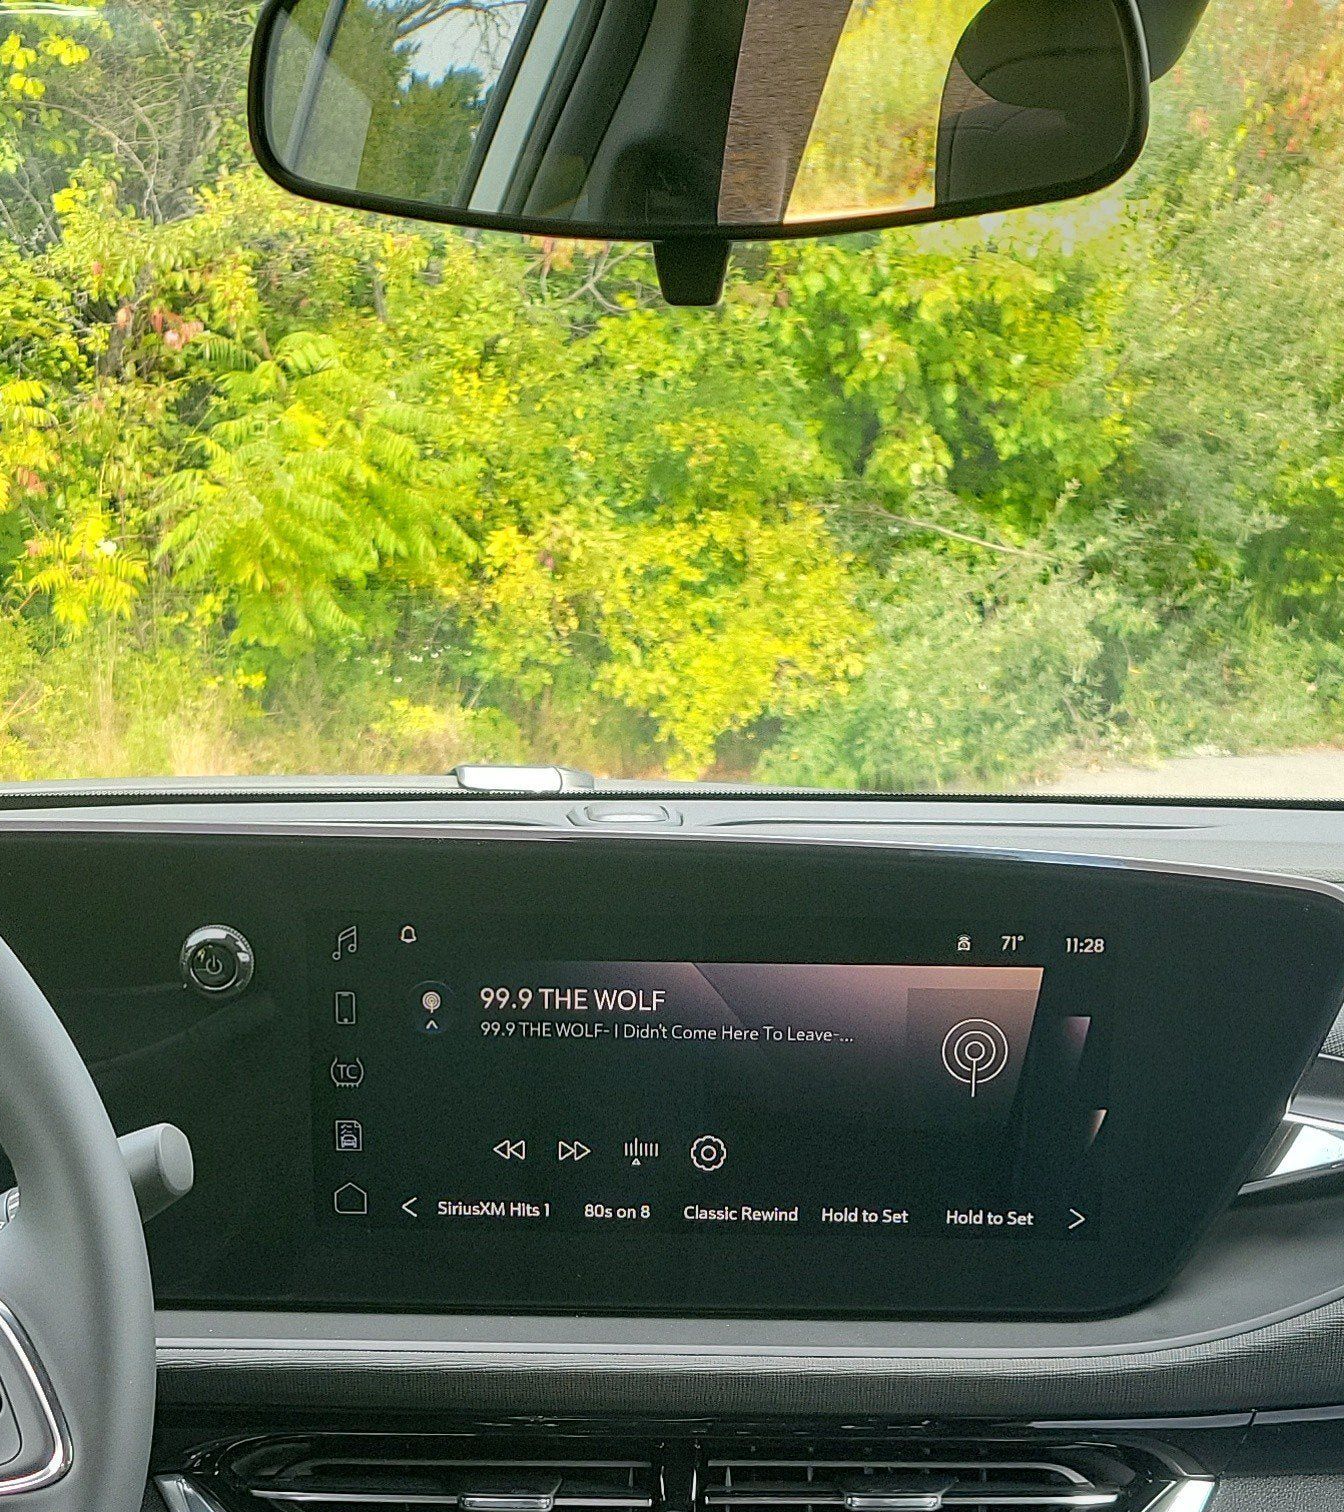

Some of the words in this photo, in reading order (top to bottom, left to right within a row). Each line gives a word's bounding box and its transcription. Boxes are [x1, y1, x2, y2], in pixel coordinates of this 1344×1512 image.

[1001, 935, 1024, 951] 71°
[1066, 937, 1105, 953] 11:28
[480, 987, 533, 1009] 99.9
[539, 988, 588, 1010] THE
[593, 989, 666, 1011] WOLF
[480, 1022, 515, 1037] 99.9
[519, 1022, 552, 1037] THE
[556, 1023, 610, 1038] WOLF-
[614, 1024, 618, 1038] I
[623, 1023, 667, 1039] Didn't
[671, 1025, 717, 1040] Come
[722, 1025, 759, 1041] Here
[763, 1026, 783, 1041] To
[337, 1064, 357, 1079] TC
[437, 1201, 505, 1216] SiriusXM
[510, 1203, 540, 1217] Hits
[544, 1203, 550, 1217] 1
[584, 1204, 612, 1218] 80s
[616, 1207, 636, 1219] on
[640, 1204, 650, 1219] 8
[683, 1205, 738, 1220] Classic
[741, 1207, 799, 1221] Rewind
[821, 1208, 858, 1222] Hold
[862, 1210, 878, 1223] to
[881, 1209, 909, 1223] Set
[946, 1209, 983, 1225] Hold
[987, 1211, 1004, 1225] to
[1007, 1211, 1034, 1226] Set
